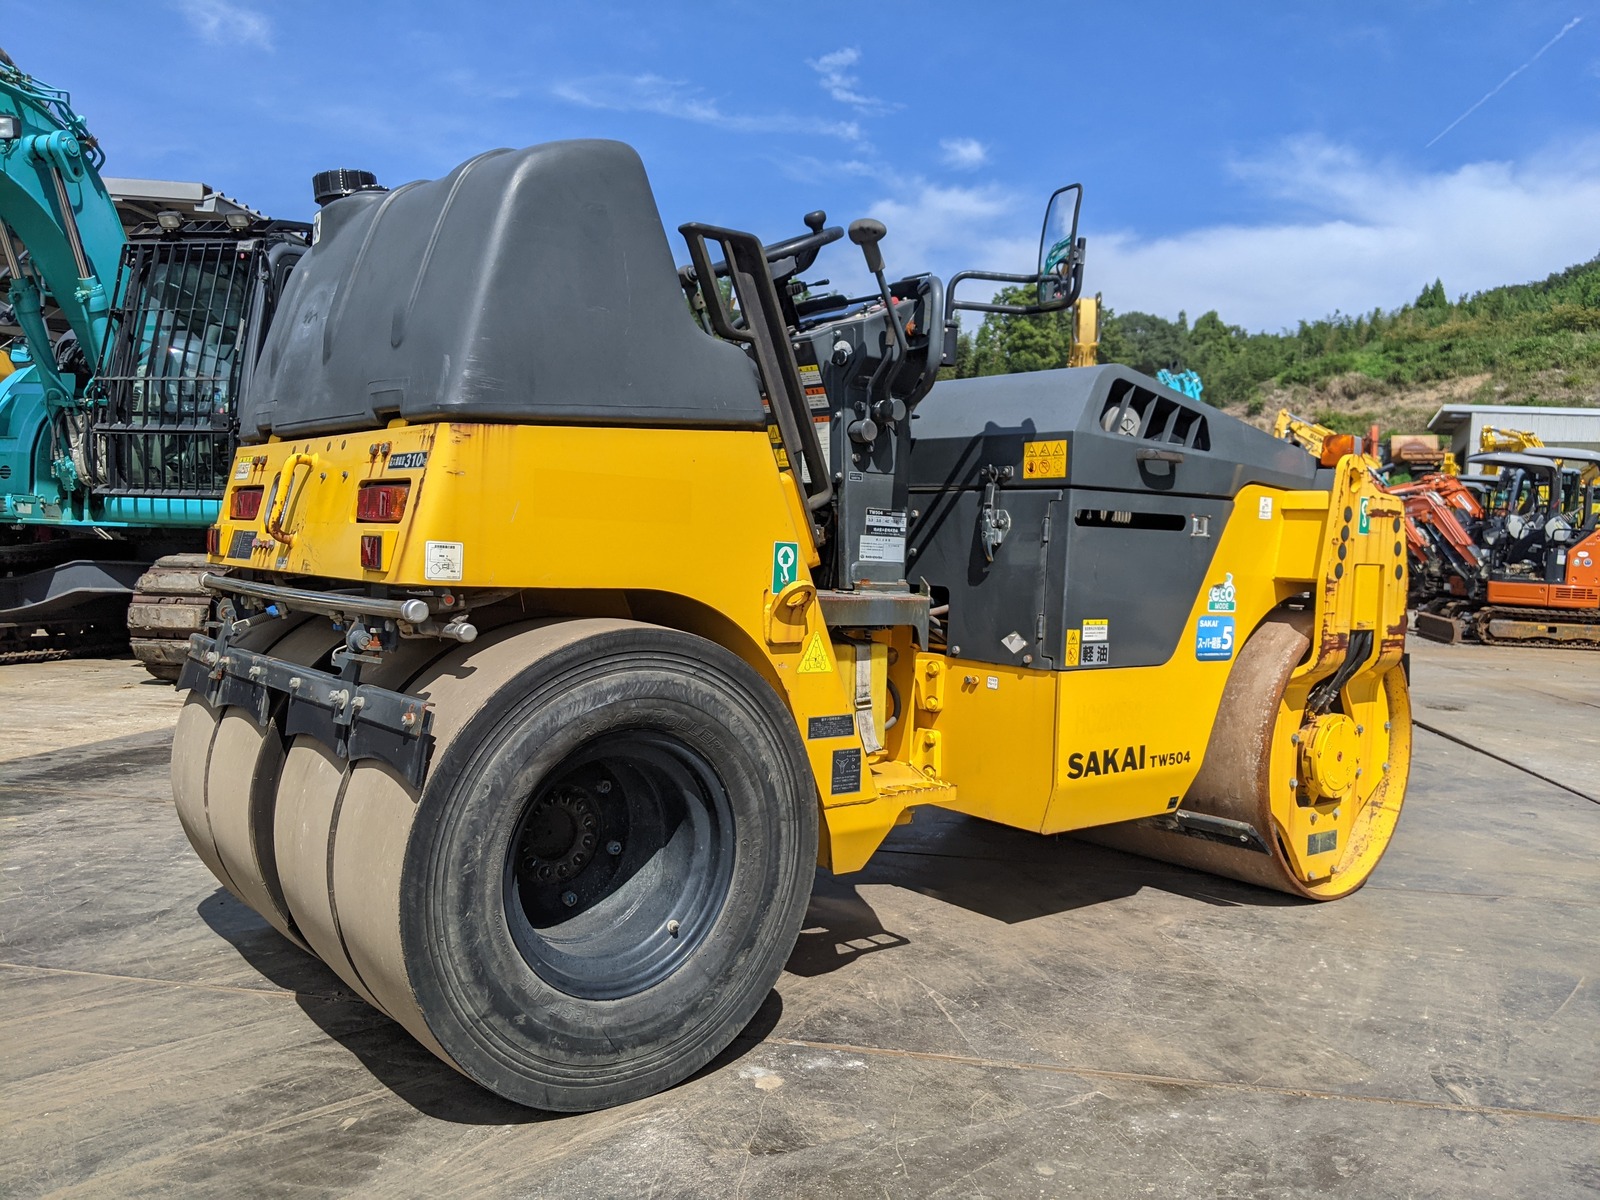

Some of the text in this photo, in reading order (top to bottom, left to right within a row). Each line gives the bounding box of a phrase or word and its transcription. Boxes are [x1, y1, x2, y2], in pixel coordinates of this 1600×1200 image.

[1211, 586, 1234, 602] eco
[1214, 602, 1229, 610] MODE
[1200, 620, 1219, 628] SAKAI
[1221, 626, 1233, 650] 5
[1082, 645, 1108, 663] 軽油
[648, 708, 725, 751] ROLLER
[1067, 745, 1191, 779] SAKAI TW504
